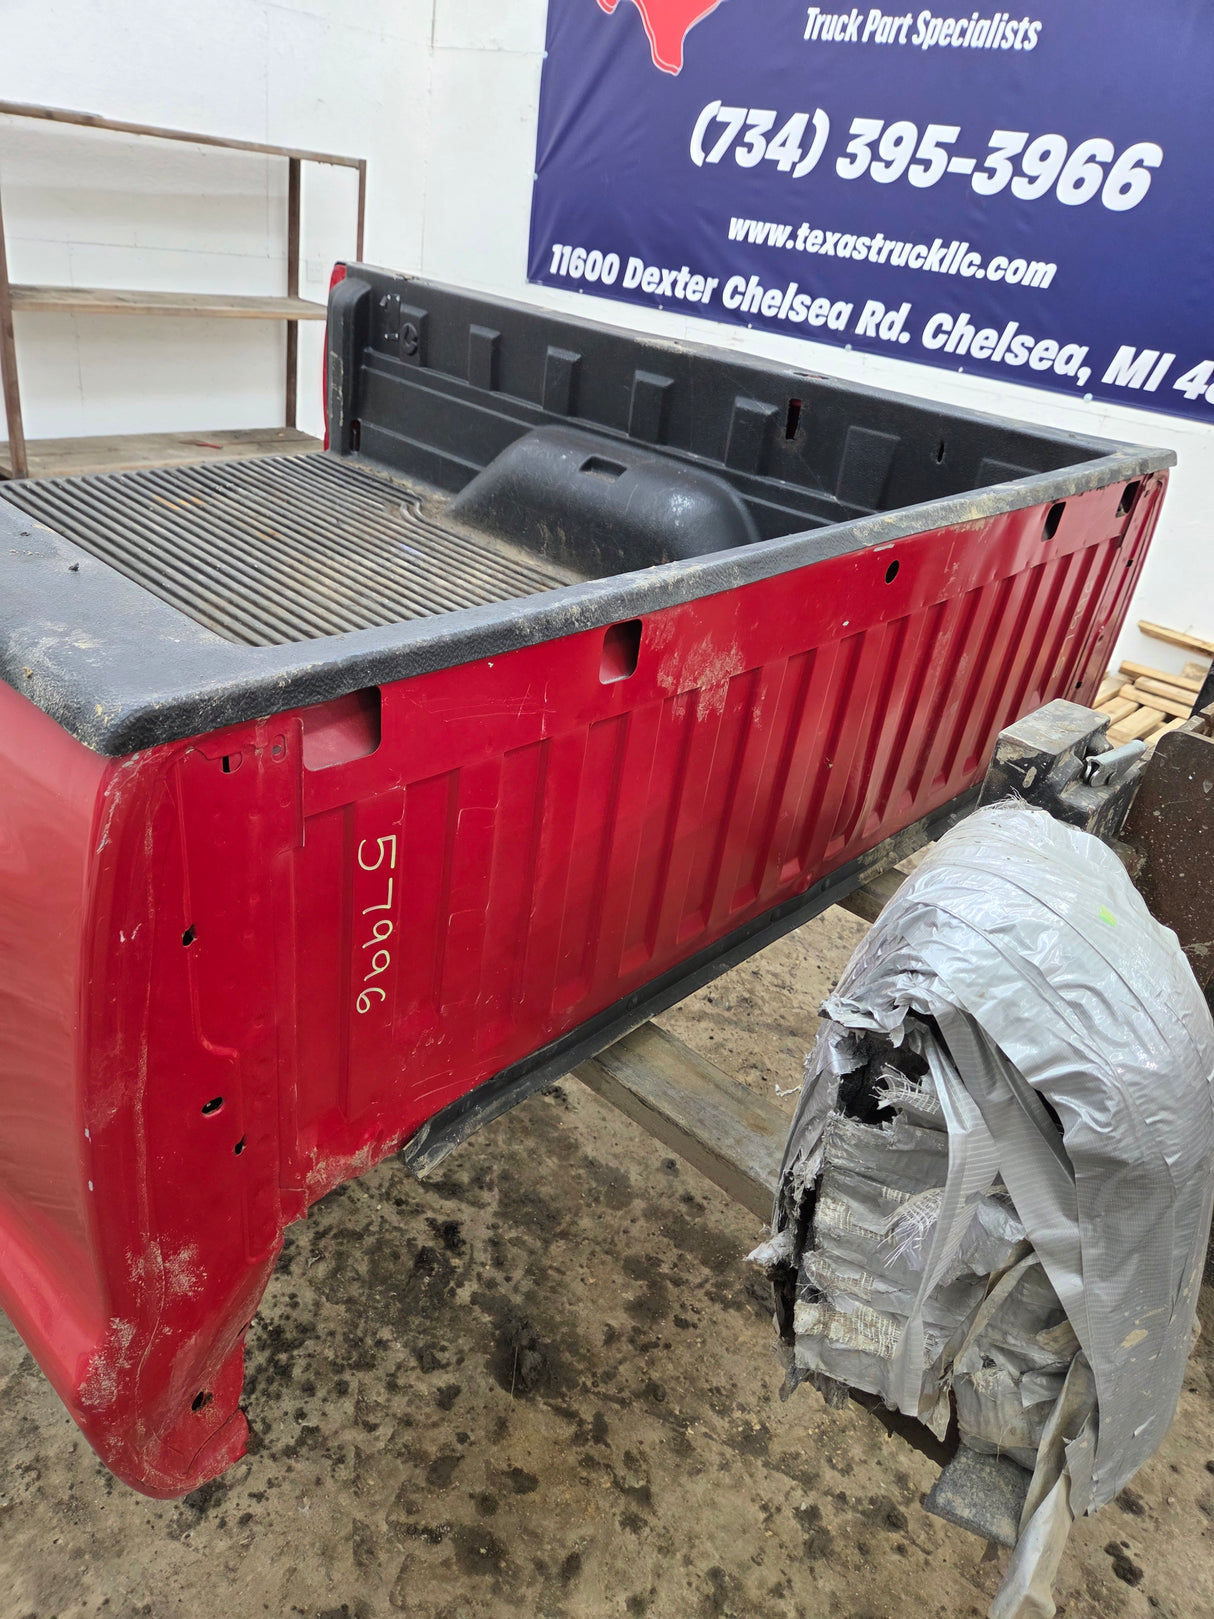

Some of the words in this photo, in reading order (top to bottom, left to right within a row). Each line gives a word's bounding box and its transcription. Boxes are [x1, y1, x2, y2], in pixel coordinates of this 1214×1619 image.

[803, 7, 864, 42] Truck
[861, 9, 914, 45] Part
[911, 10, 1043, 51] Specialists
[689, 99, 830, 179] (734)
[835, 117, 1164, 212] 395-3966
[727, 216, 1058, 289] www.texastruckllc.com
[549, 243, 621, 286] 11600
[622, 256, 720, 305] Dexter
[722, 274, 854, 332] Chelsea
[854, 299, 912, 345] Rd.
[921, 312, 1092, 387] Chelsea,
[1100, 344, 1177, 393] MI
[1172, 359, 1214, 405] 4
[356, 834, 397, 1014] 57996
